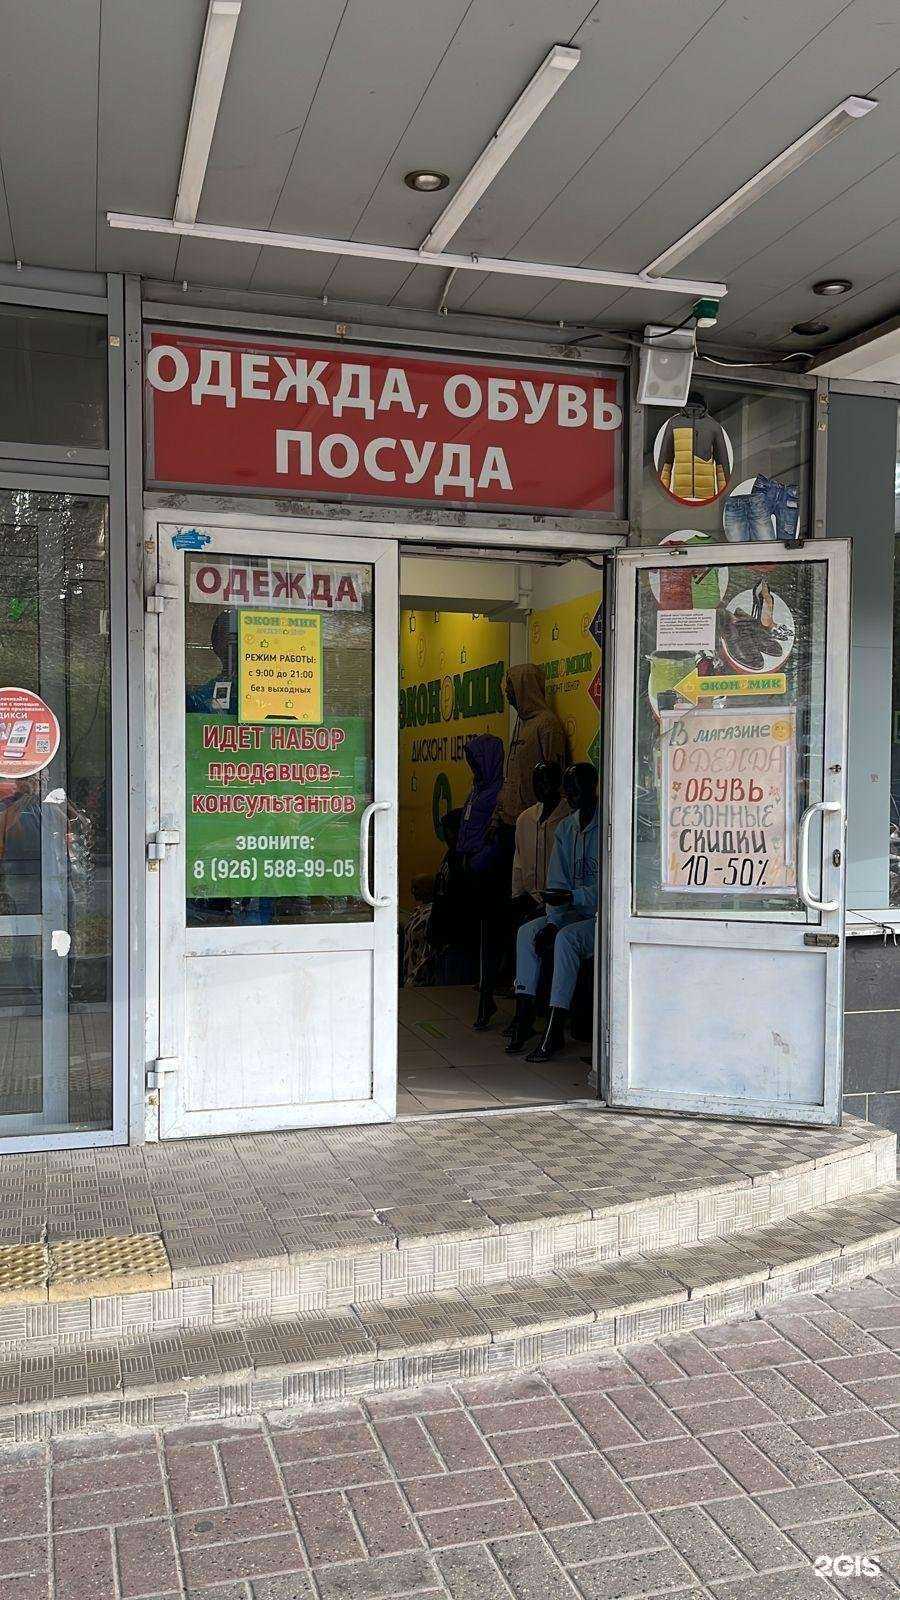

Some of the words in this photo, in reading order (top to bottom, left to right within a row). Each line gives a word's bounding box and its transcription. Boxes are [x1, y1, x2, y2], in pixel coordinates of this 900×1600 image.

[145, 344, 429, 420] ОДЕЖДА,
[443, 374, 623, 431] ОБУВЬ
[275, 429, 514, 498] ПОСУДА
[195, 566, 358, 608] ОДЕЖДА
[245, 653, 277, 663] РЕЖИМ
[279, 654, 317, 665] РАБОТЫ:
[255, 669, 274, 678] 9:00
[290, 670, 314, 679] 21:00
[250, 684, 267, 693] без
[268, 686, 311, 695] выходных
[271, 727, 345, 750] НАБОР
[669, 721, 688, 746] В
[693, 724, 771, 743] магазине
[672, 747, 783, 773] ОДЕЖДА
[208, 762, 340, 785] продавцов-
[685, 778, 764, 802] ОБУВЬ
[192, 795, 356, 819] консультантов
[670, 804, 774, 828] СЕЗОННЫЕ
[235, 835, 315, 850] звоните:
[679, 828, 767, 853] СКИДКИ
[193, 860, 205, 879] 8
[211, 858, 258, 881] (926)
[264, 859, 355, 878] 588-99-05
